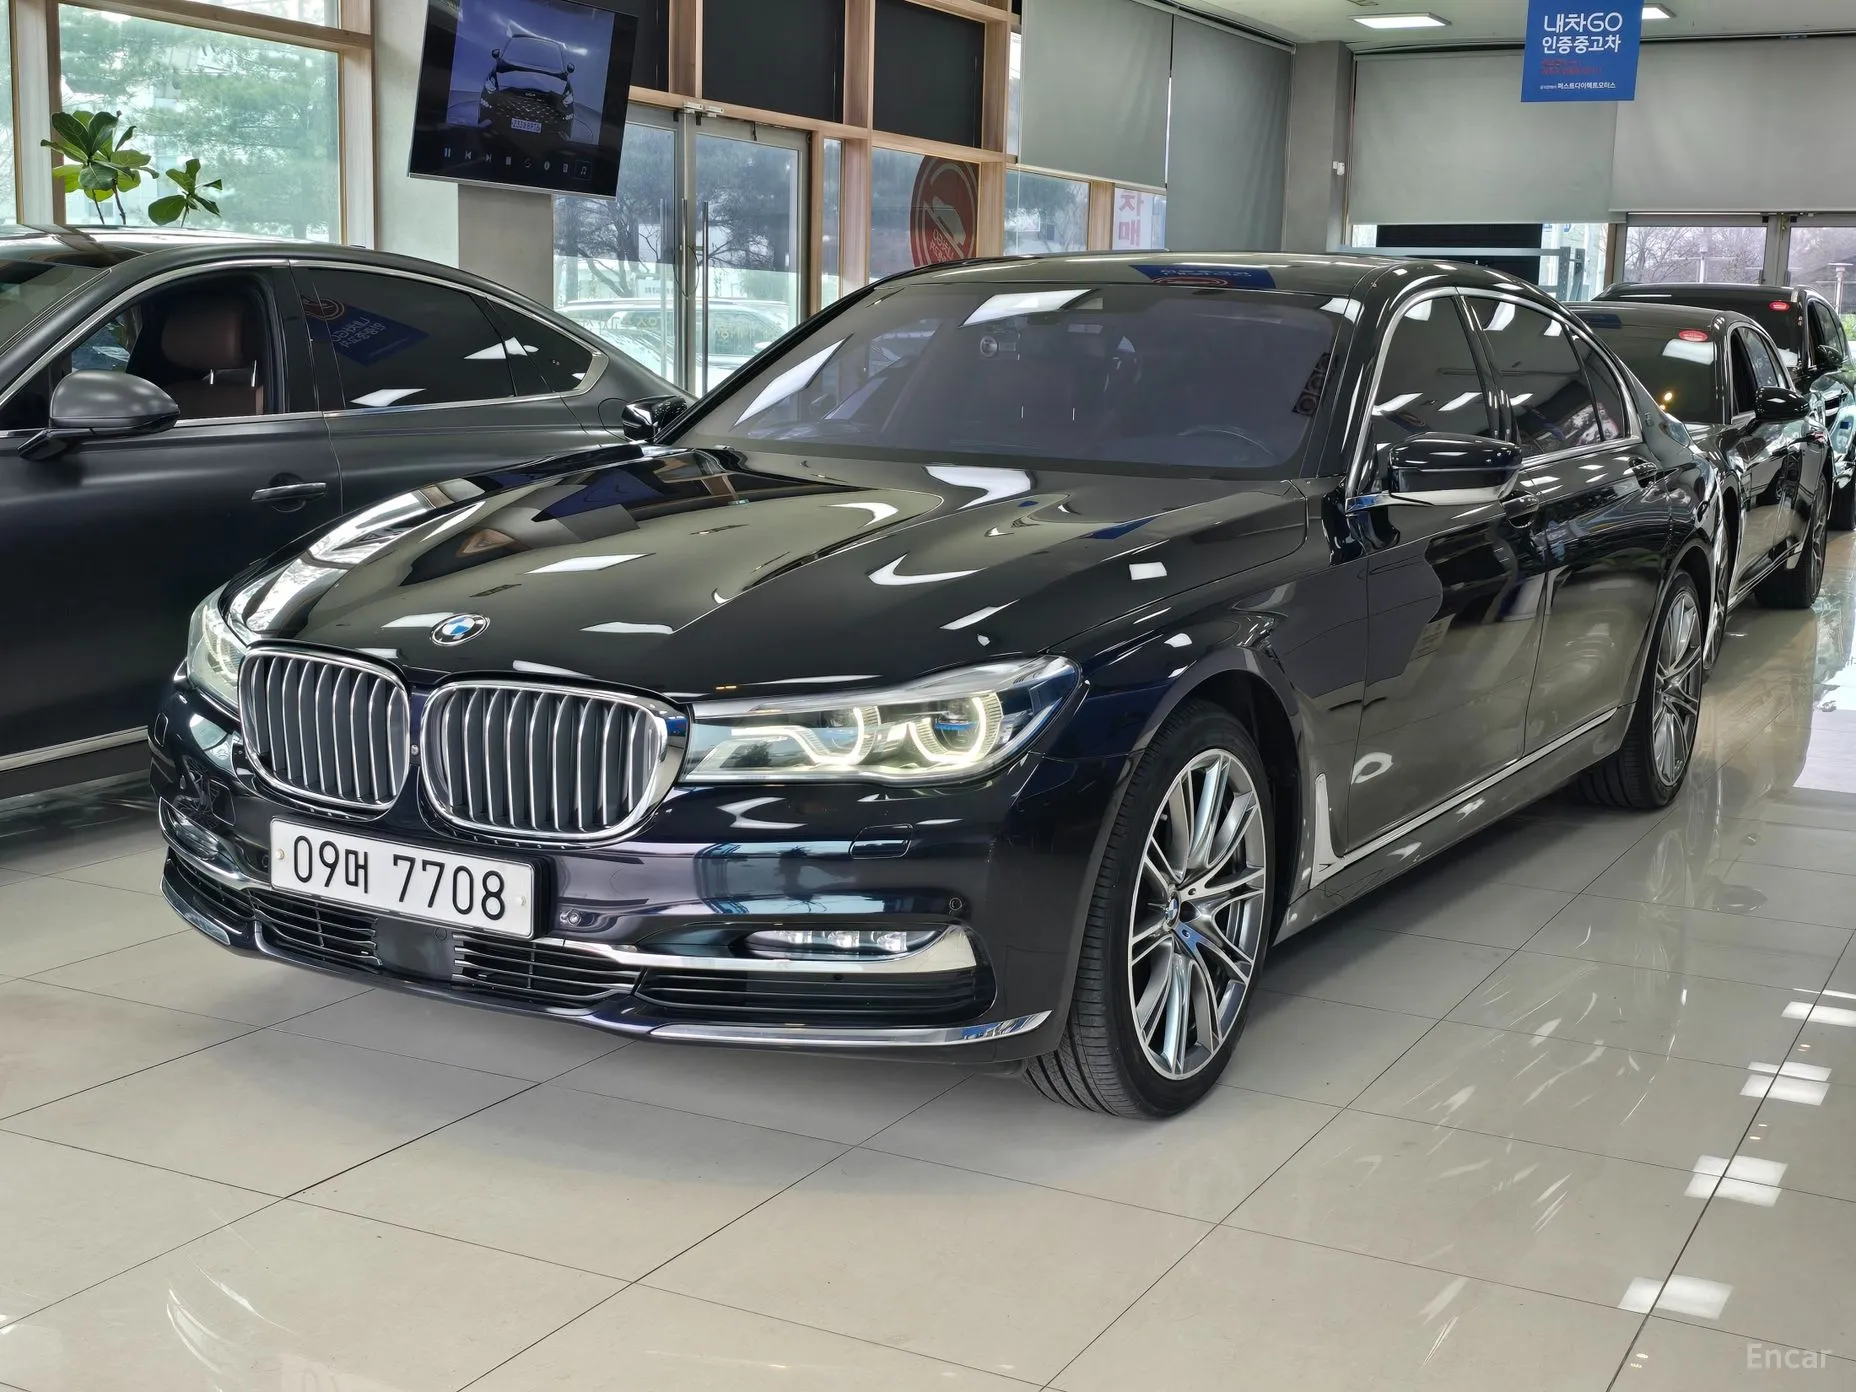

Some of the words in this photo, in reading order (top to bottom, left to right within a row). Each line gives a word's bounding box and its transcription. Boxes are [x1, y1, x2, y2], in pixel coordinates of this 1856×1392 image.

[1544, 12, 1623, 33] 내차GO
[1542, 34, 1621, 54] 인증중고차
[293, 835, 369, 894] 09머
[392, 853, 505, 921] 7708
